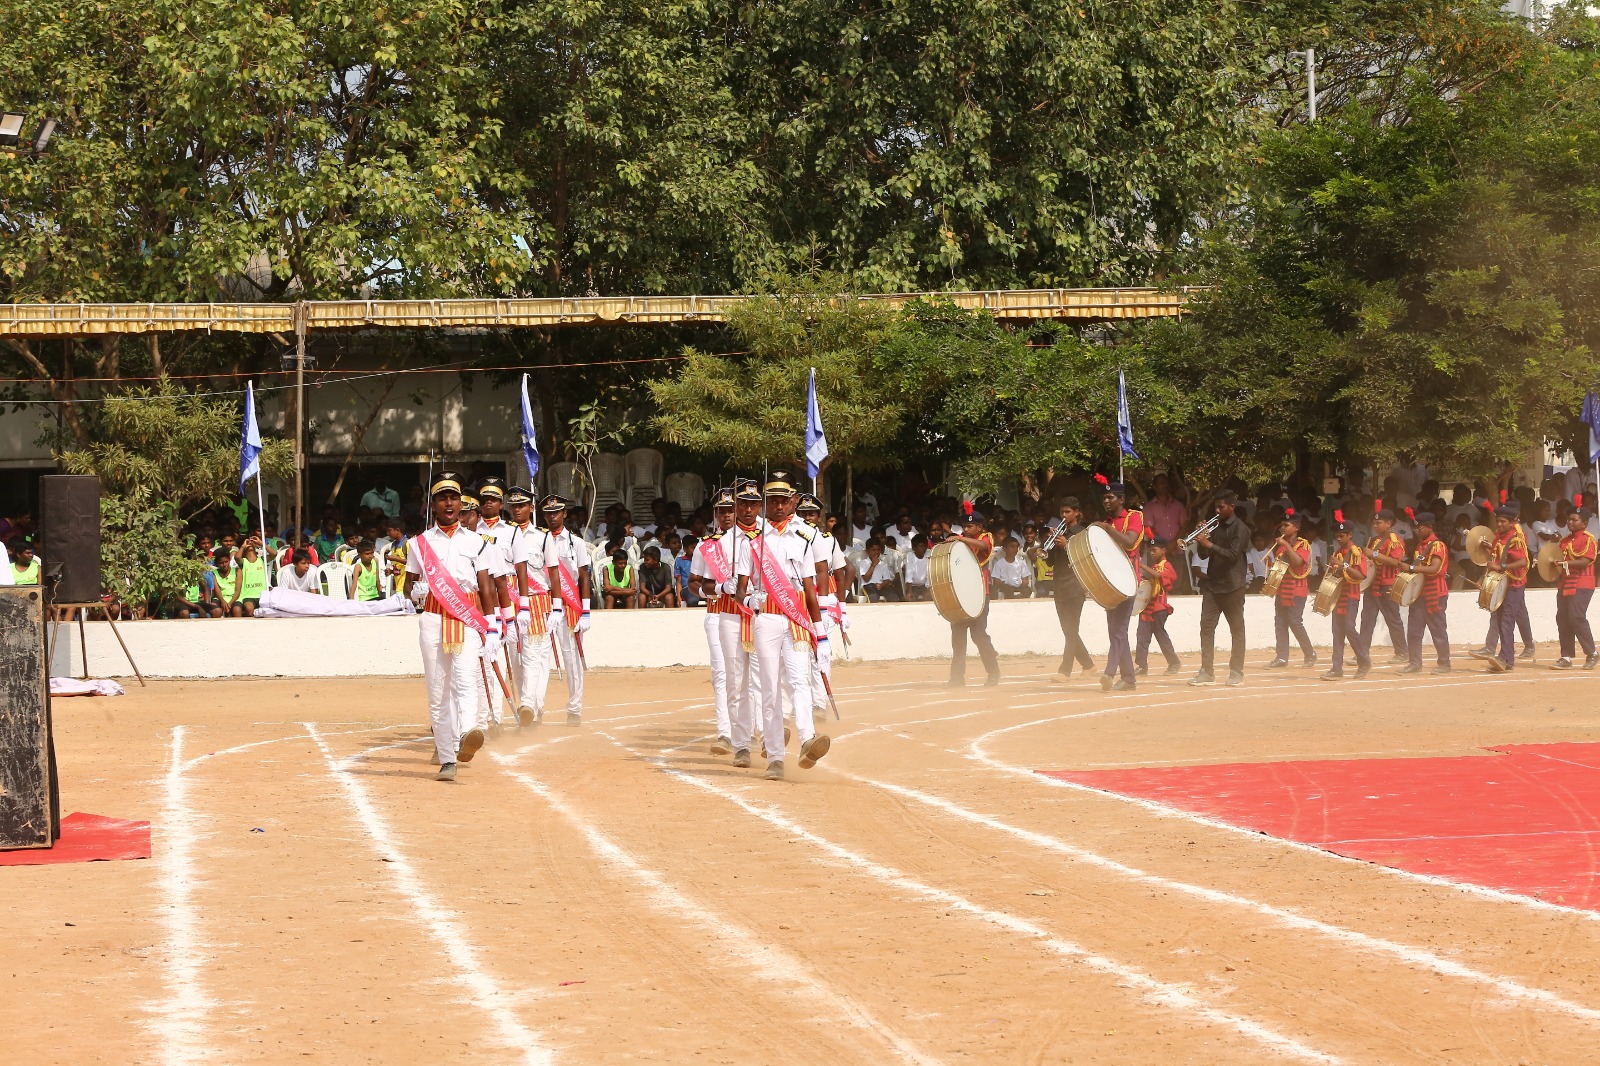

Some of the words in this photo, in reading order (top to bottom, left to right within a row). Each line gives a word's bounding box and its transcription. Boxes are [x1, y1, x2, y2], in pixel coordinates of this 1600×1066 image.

[762, 562, 779, 585] SCHOOL
[434, 577, 446, 590] CK
[441, 584, 461, 609] SCHOOL
[454, 603, 467, 615] OF
[773, 583, 784, 592] OF
[777, 590, 799, 620] PRACTICAL
